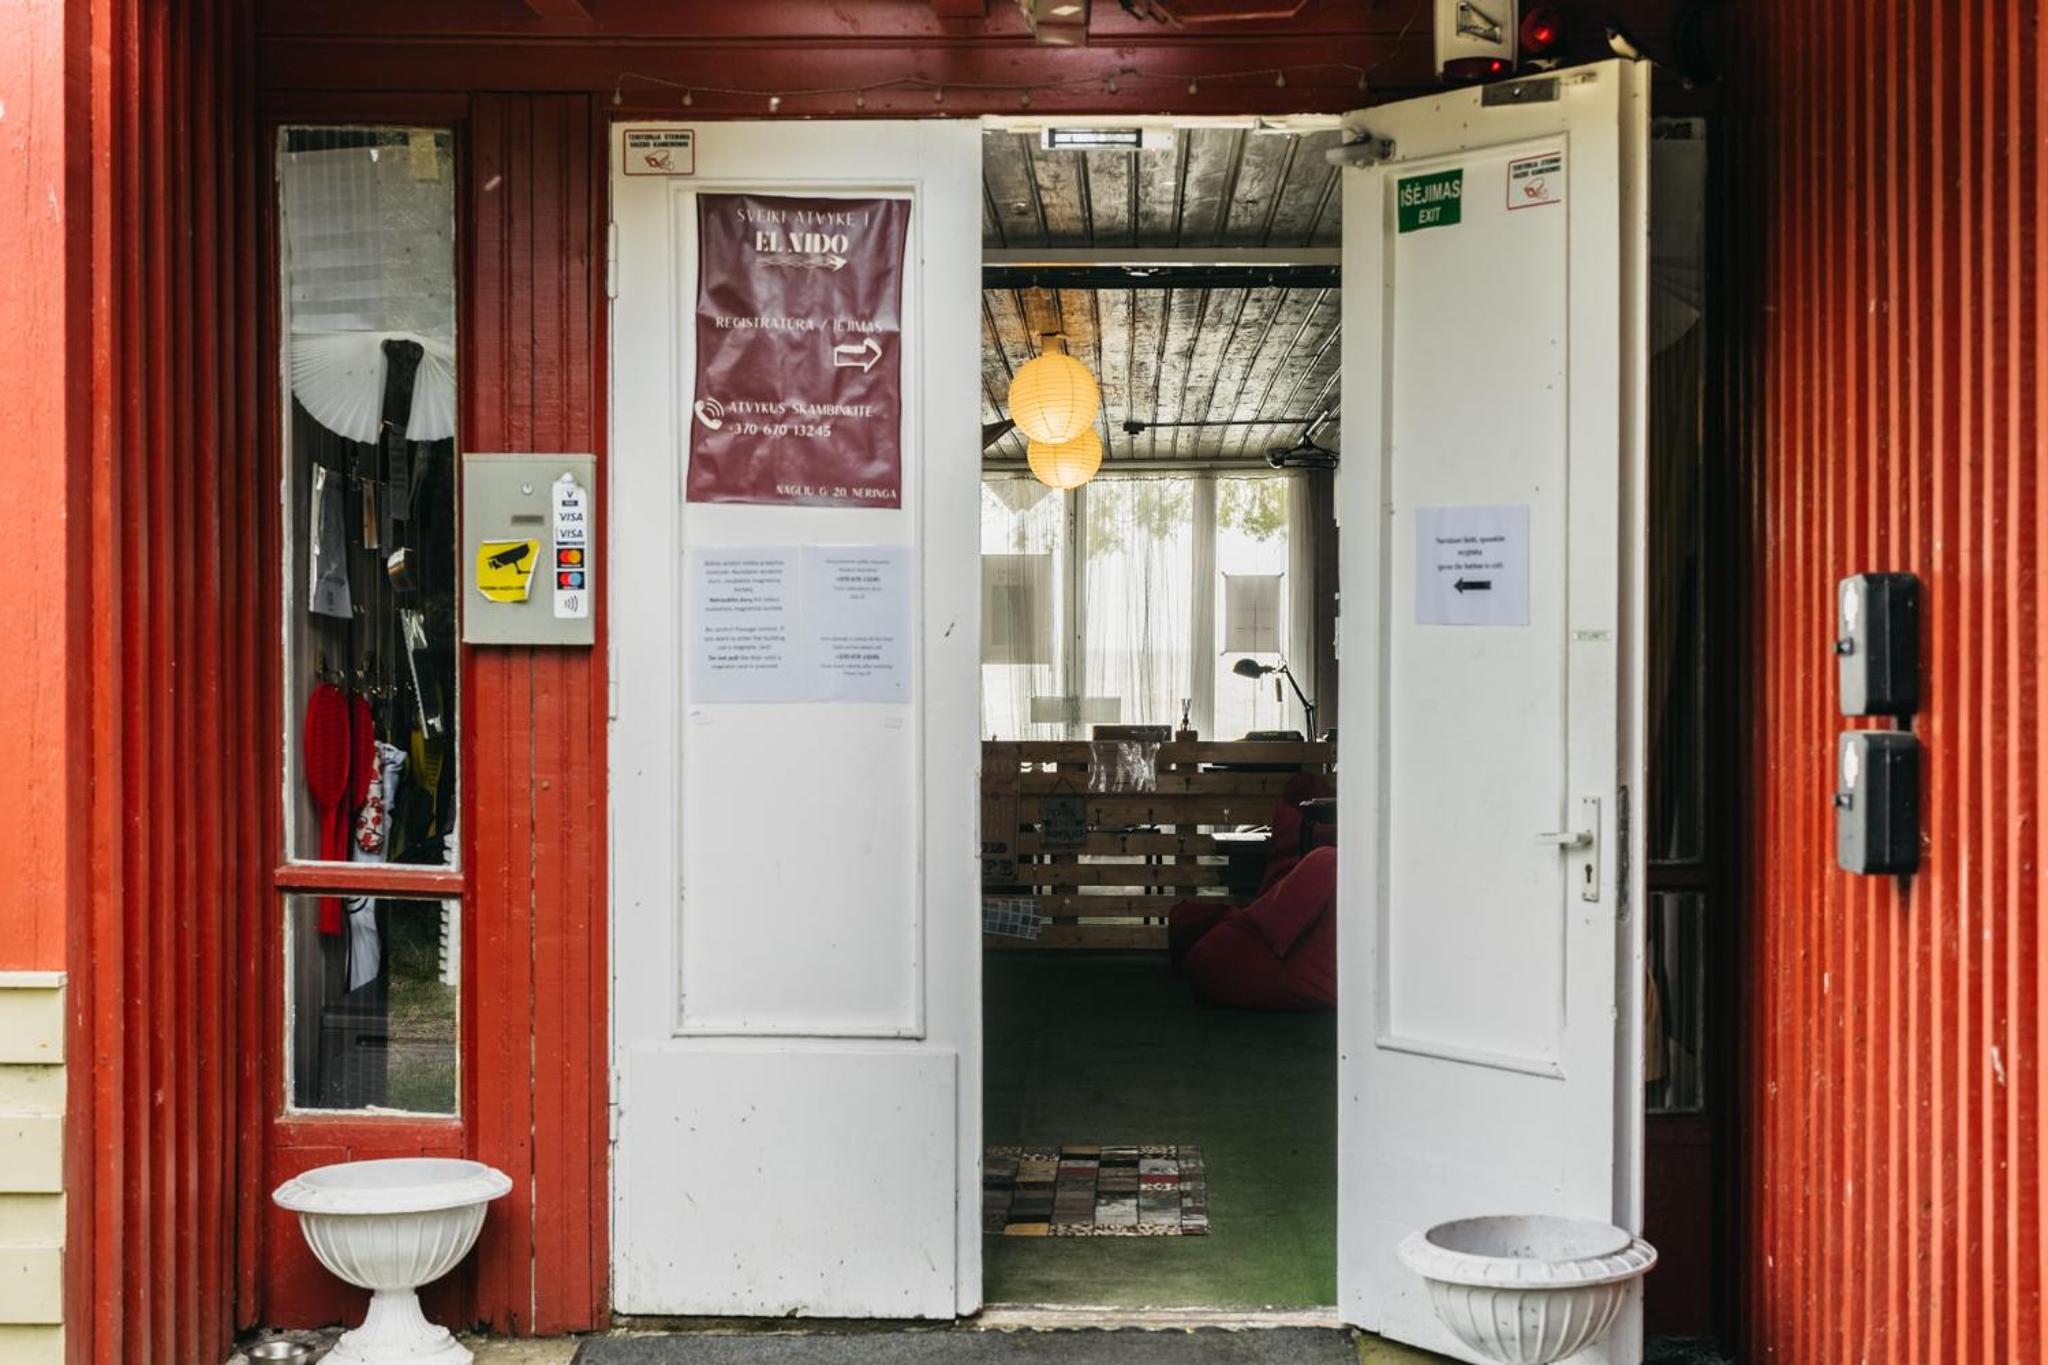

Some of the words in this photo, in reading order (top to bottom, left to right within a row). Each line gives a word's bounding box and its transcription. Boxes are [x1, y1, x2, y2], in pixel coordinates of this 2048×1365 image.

[1400, 179, 1461, 207] IŠĖJIMAS
[737, 208, 786, 225] SVEIKI
[1418, 206, 1442, 224] EXIT
[755, 230, 783, 252] EL
[788, 232, 849, 254] NIDO
[715, 316, 815, 331] REGISTRATURA
[729, 401, 786, 414] ATVYKUS
[792, 403, 873, 418] SKAMBINKITE
[763, 423, 788, 436] 670
[794, 425, 832, 438] 13245
[852, 487, 897, 499] NERINGA
[559, 512, 583, 522] VISA
[560, 529, 583, 538] VISA
